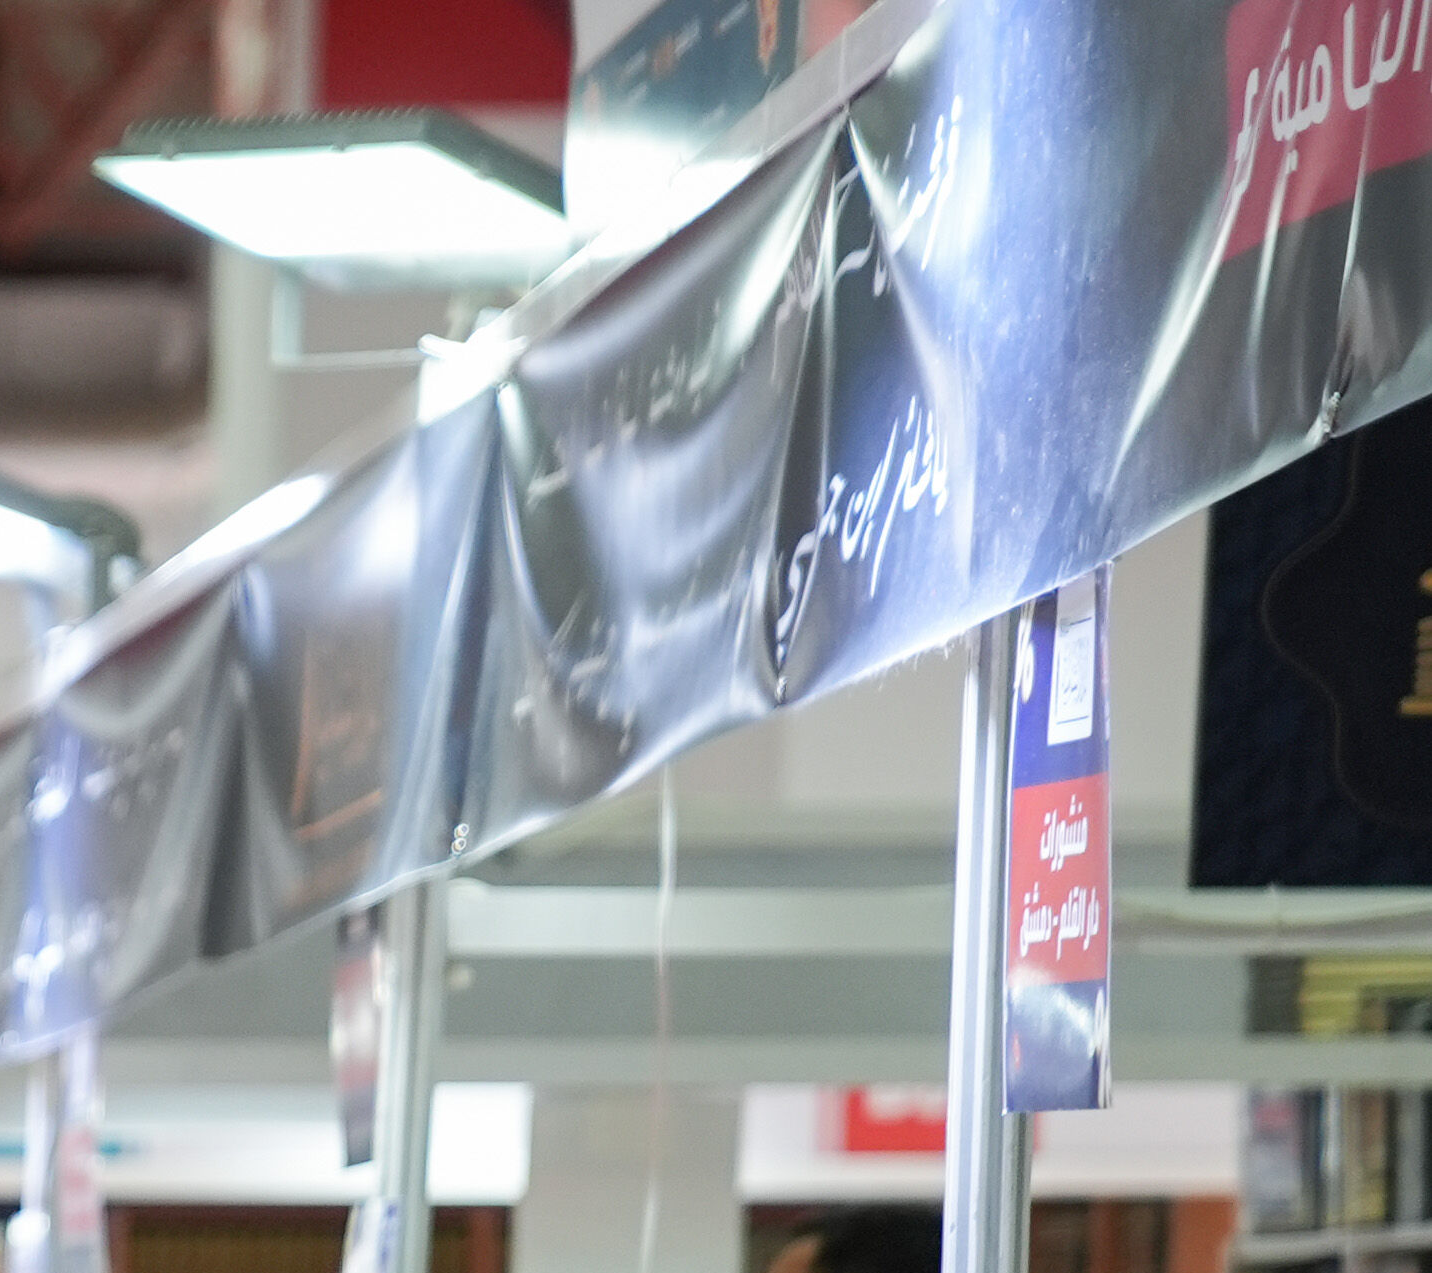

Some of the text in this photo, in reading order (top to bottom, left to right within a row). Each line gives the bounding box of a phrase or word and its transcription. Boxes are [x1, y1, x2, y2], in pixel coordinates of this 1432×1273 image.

[1040, 794, 1089, 873] منشورات
[1019, 881, 1053, 958] دمشق
[1056, 886, 1088, 962] القلم
[1083, 886, 1100, 951] دار
